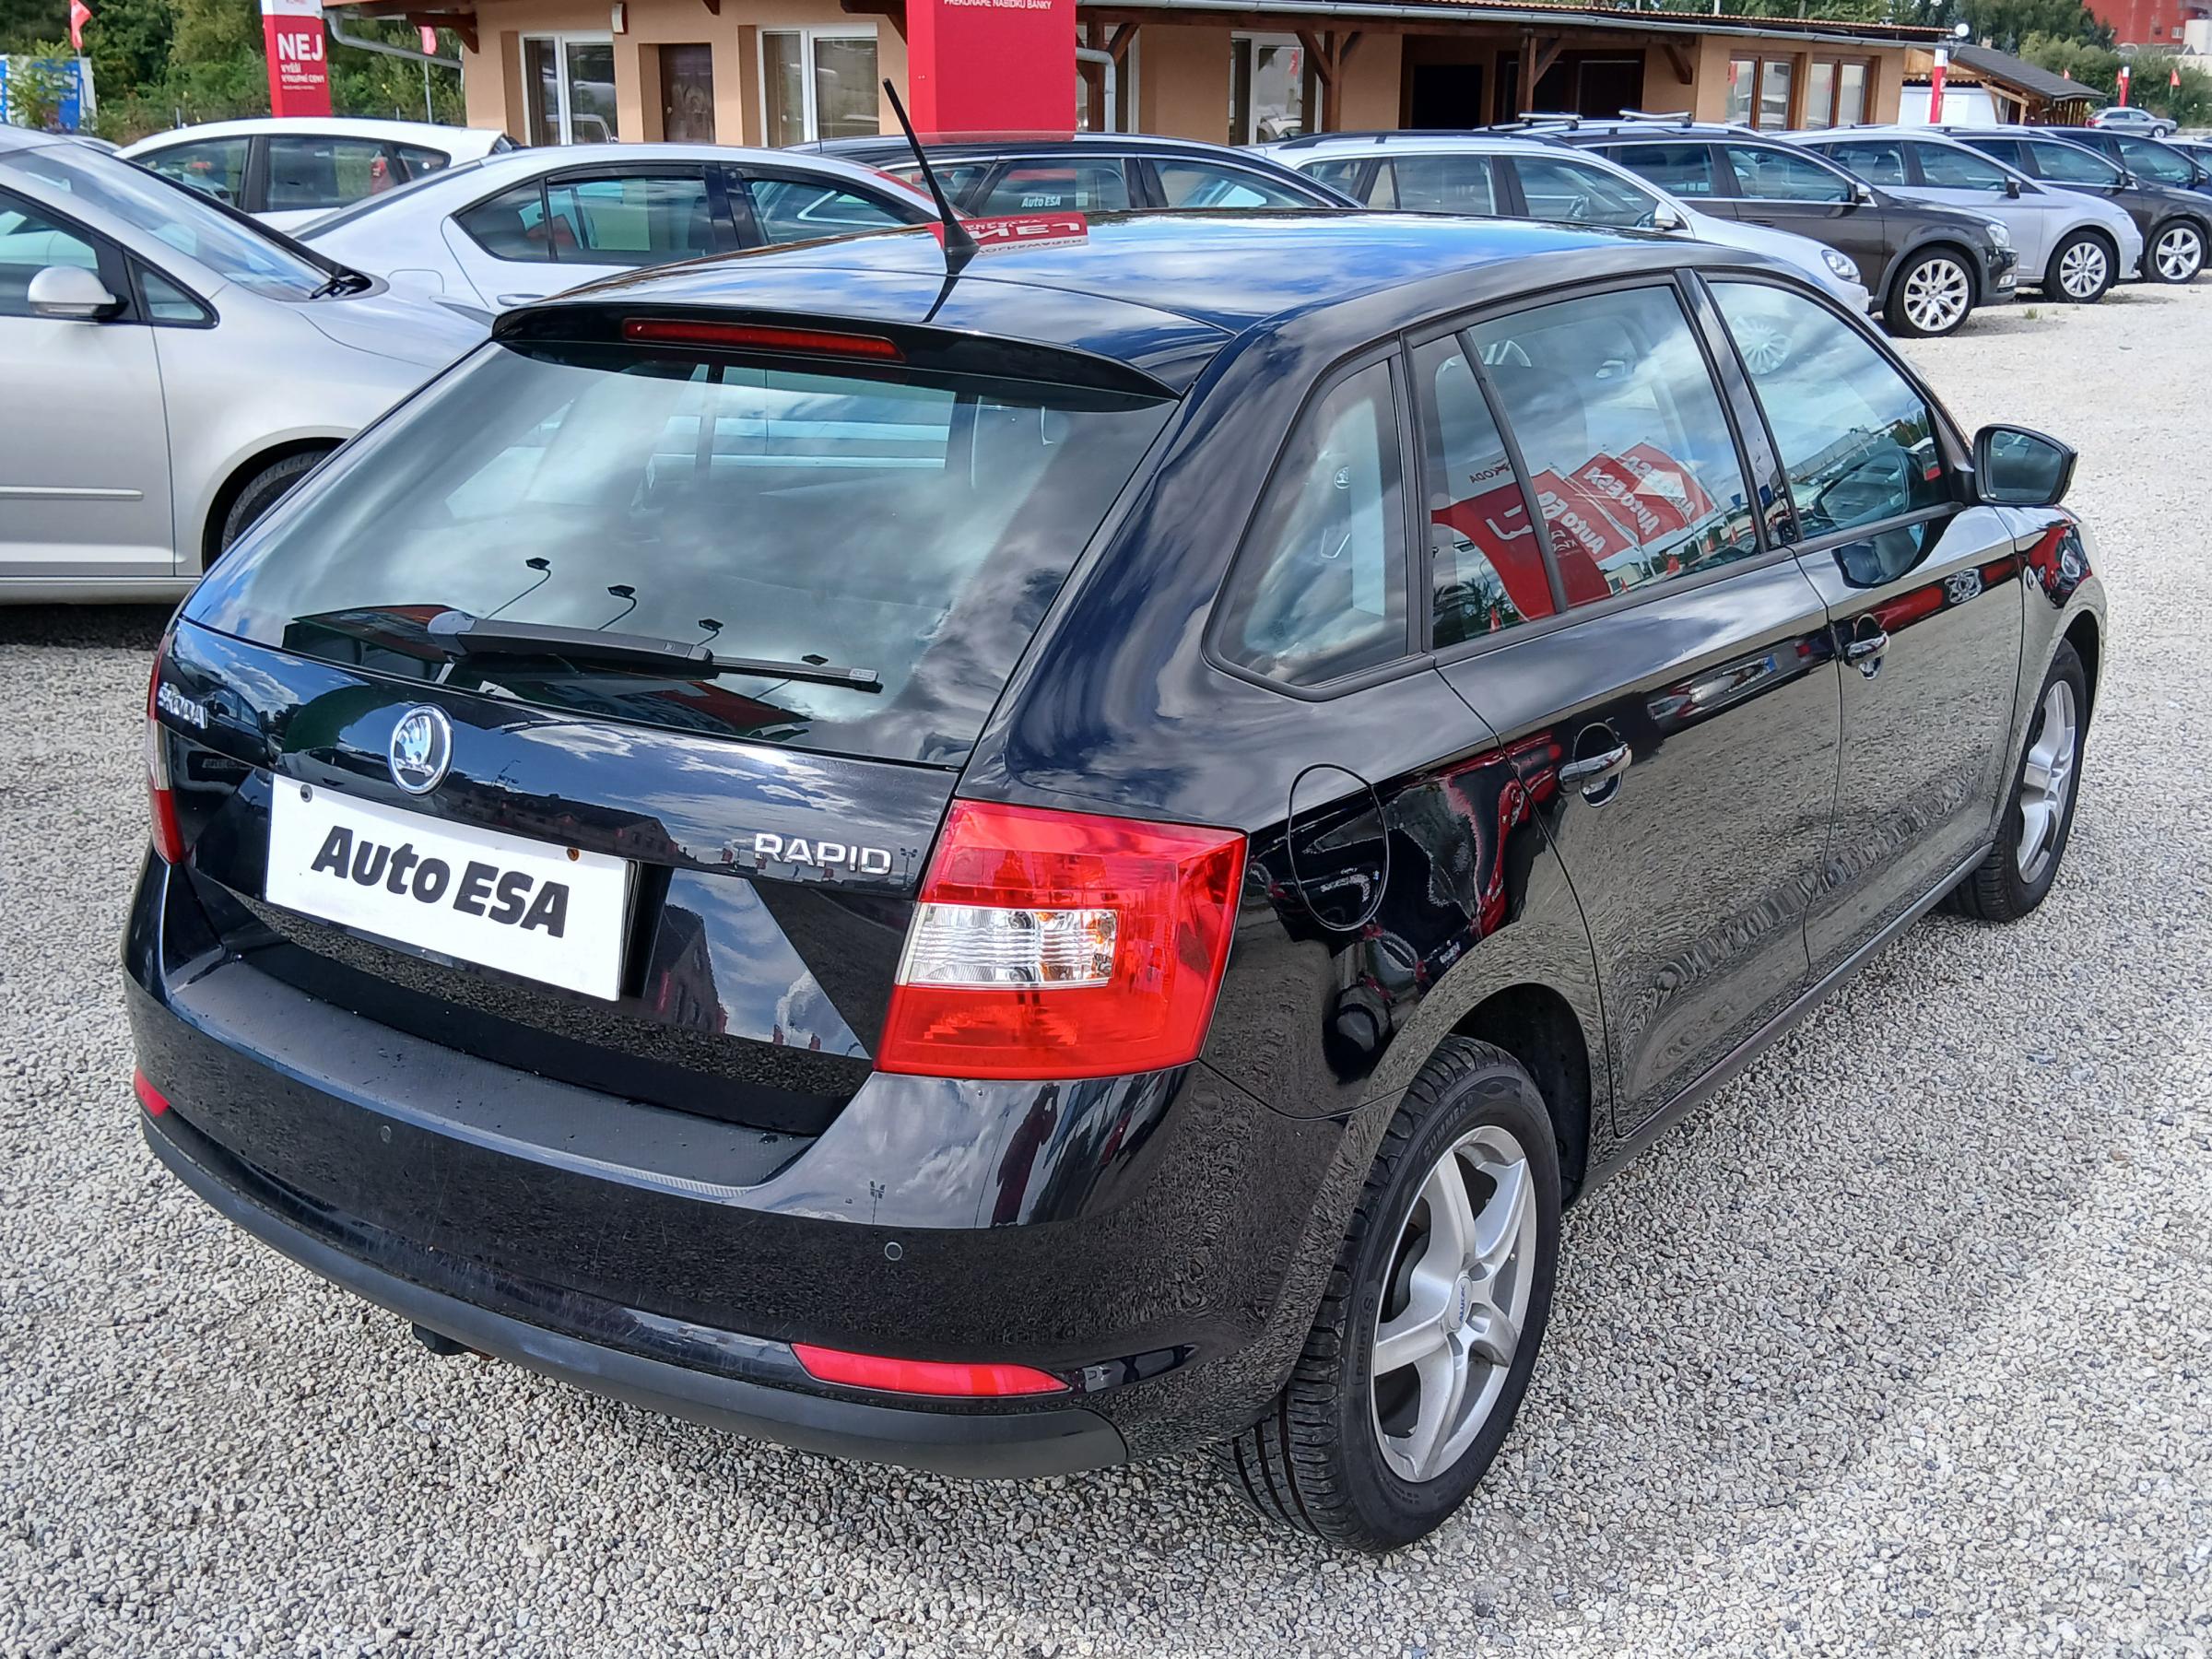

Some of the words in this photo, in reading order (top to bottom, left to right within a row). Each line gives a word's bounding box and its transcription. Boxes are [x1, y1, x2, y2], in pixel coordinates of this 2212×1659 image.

[277, 33, 324, 62] NEJ
[1021, 197, 1043, 207] Auto
[1044, 195, 1061, 206] ESA
[755, 832, 892, 876] RAPID
[311, 825, 450, 903] Auto
[453, 860, 570, 938] ESA
[1423, 1100, 1466, 1163] SUMMER
